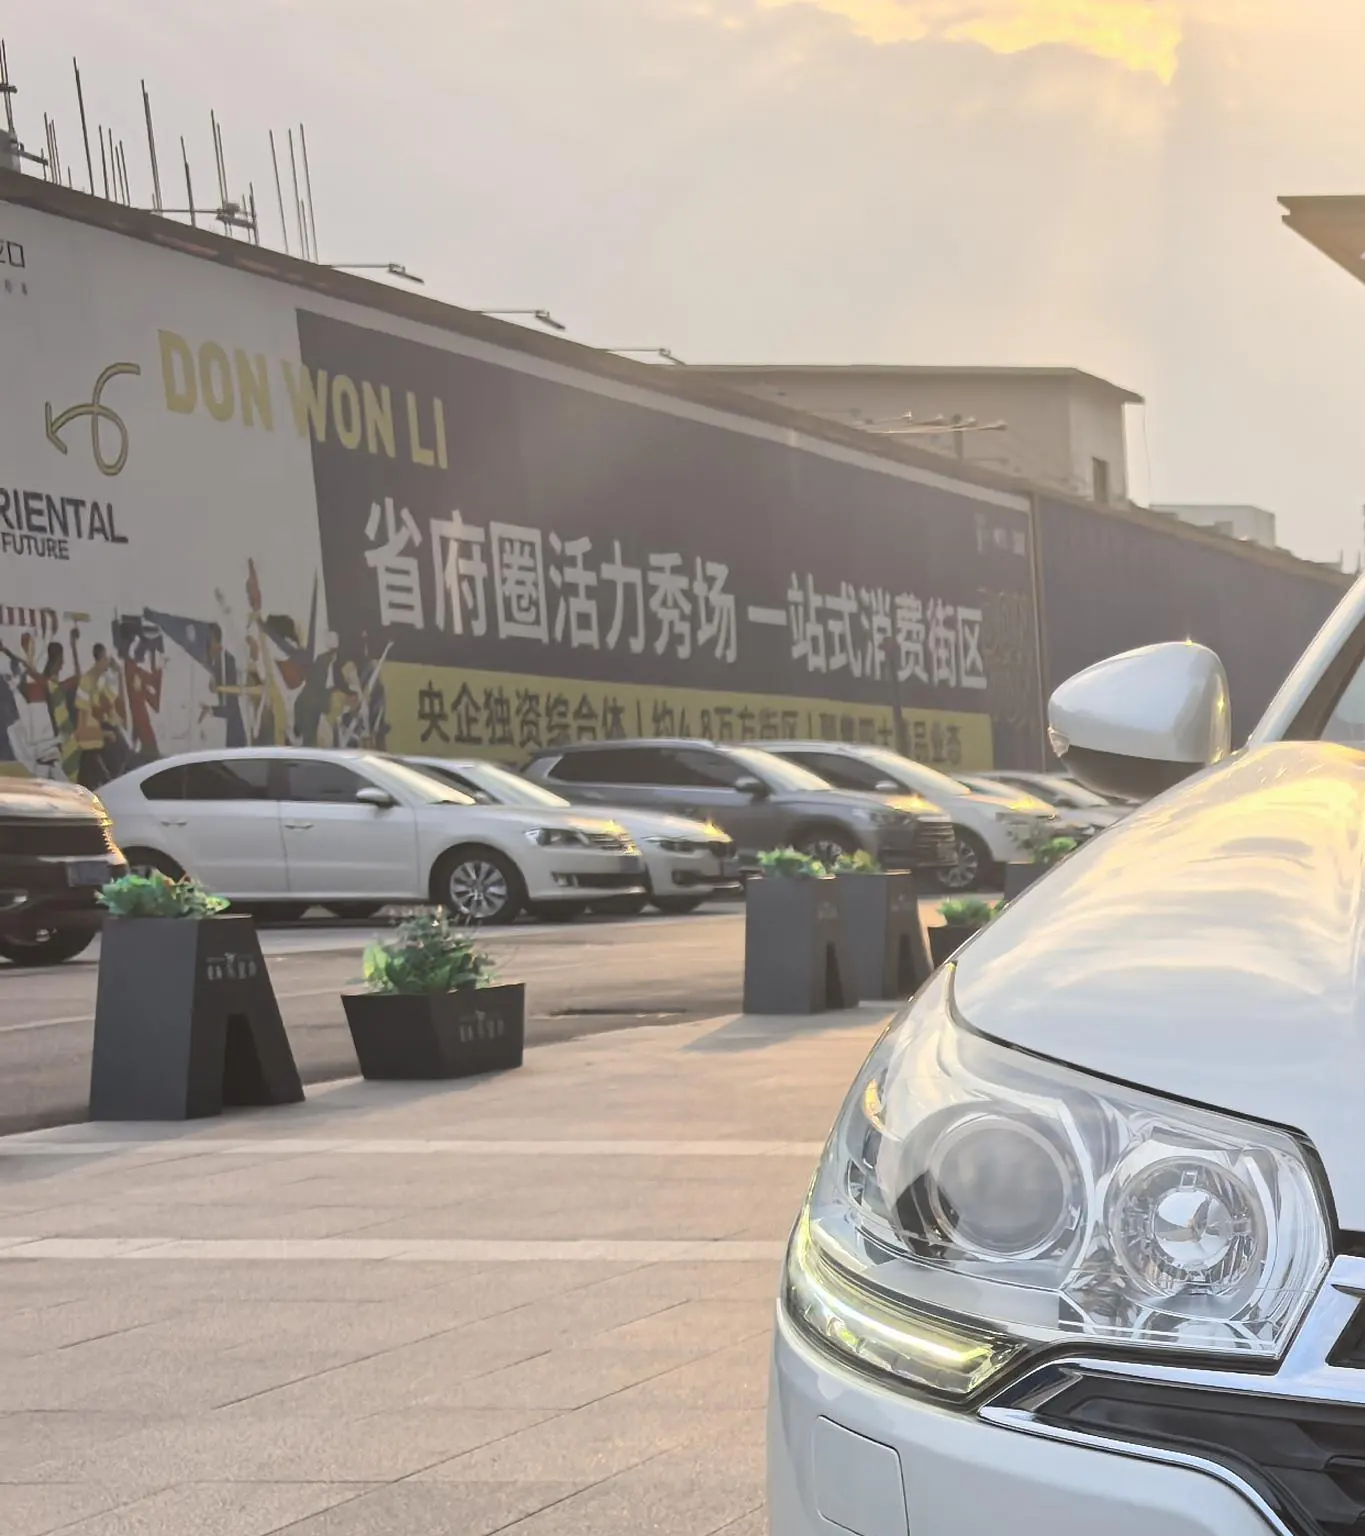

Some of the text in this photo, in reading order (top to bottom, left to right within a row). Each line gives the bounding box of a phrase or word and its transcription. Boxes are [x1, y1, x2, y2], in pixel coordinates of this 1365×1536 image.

[157, 328, 448, 470] DON WON LI
[1, 532, 70, 561] FUTURE
